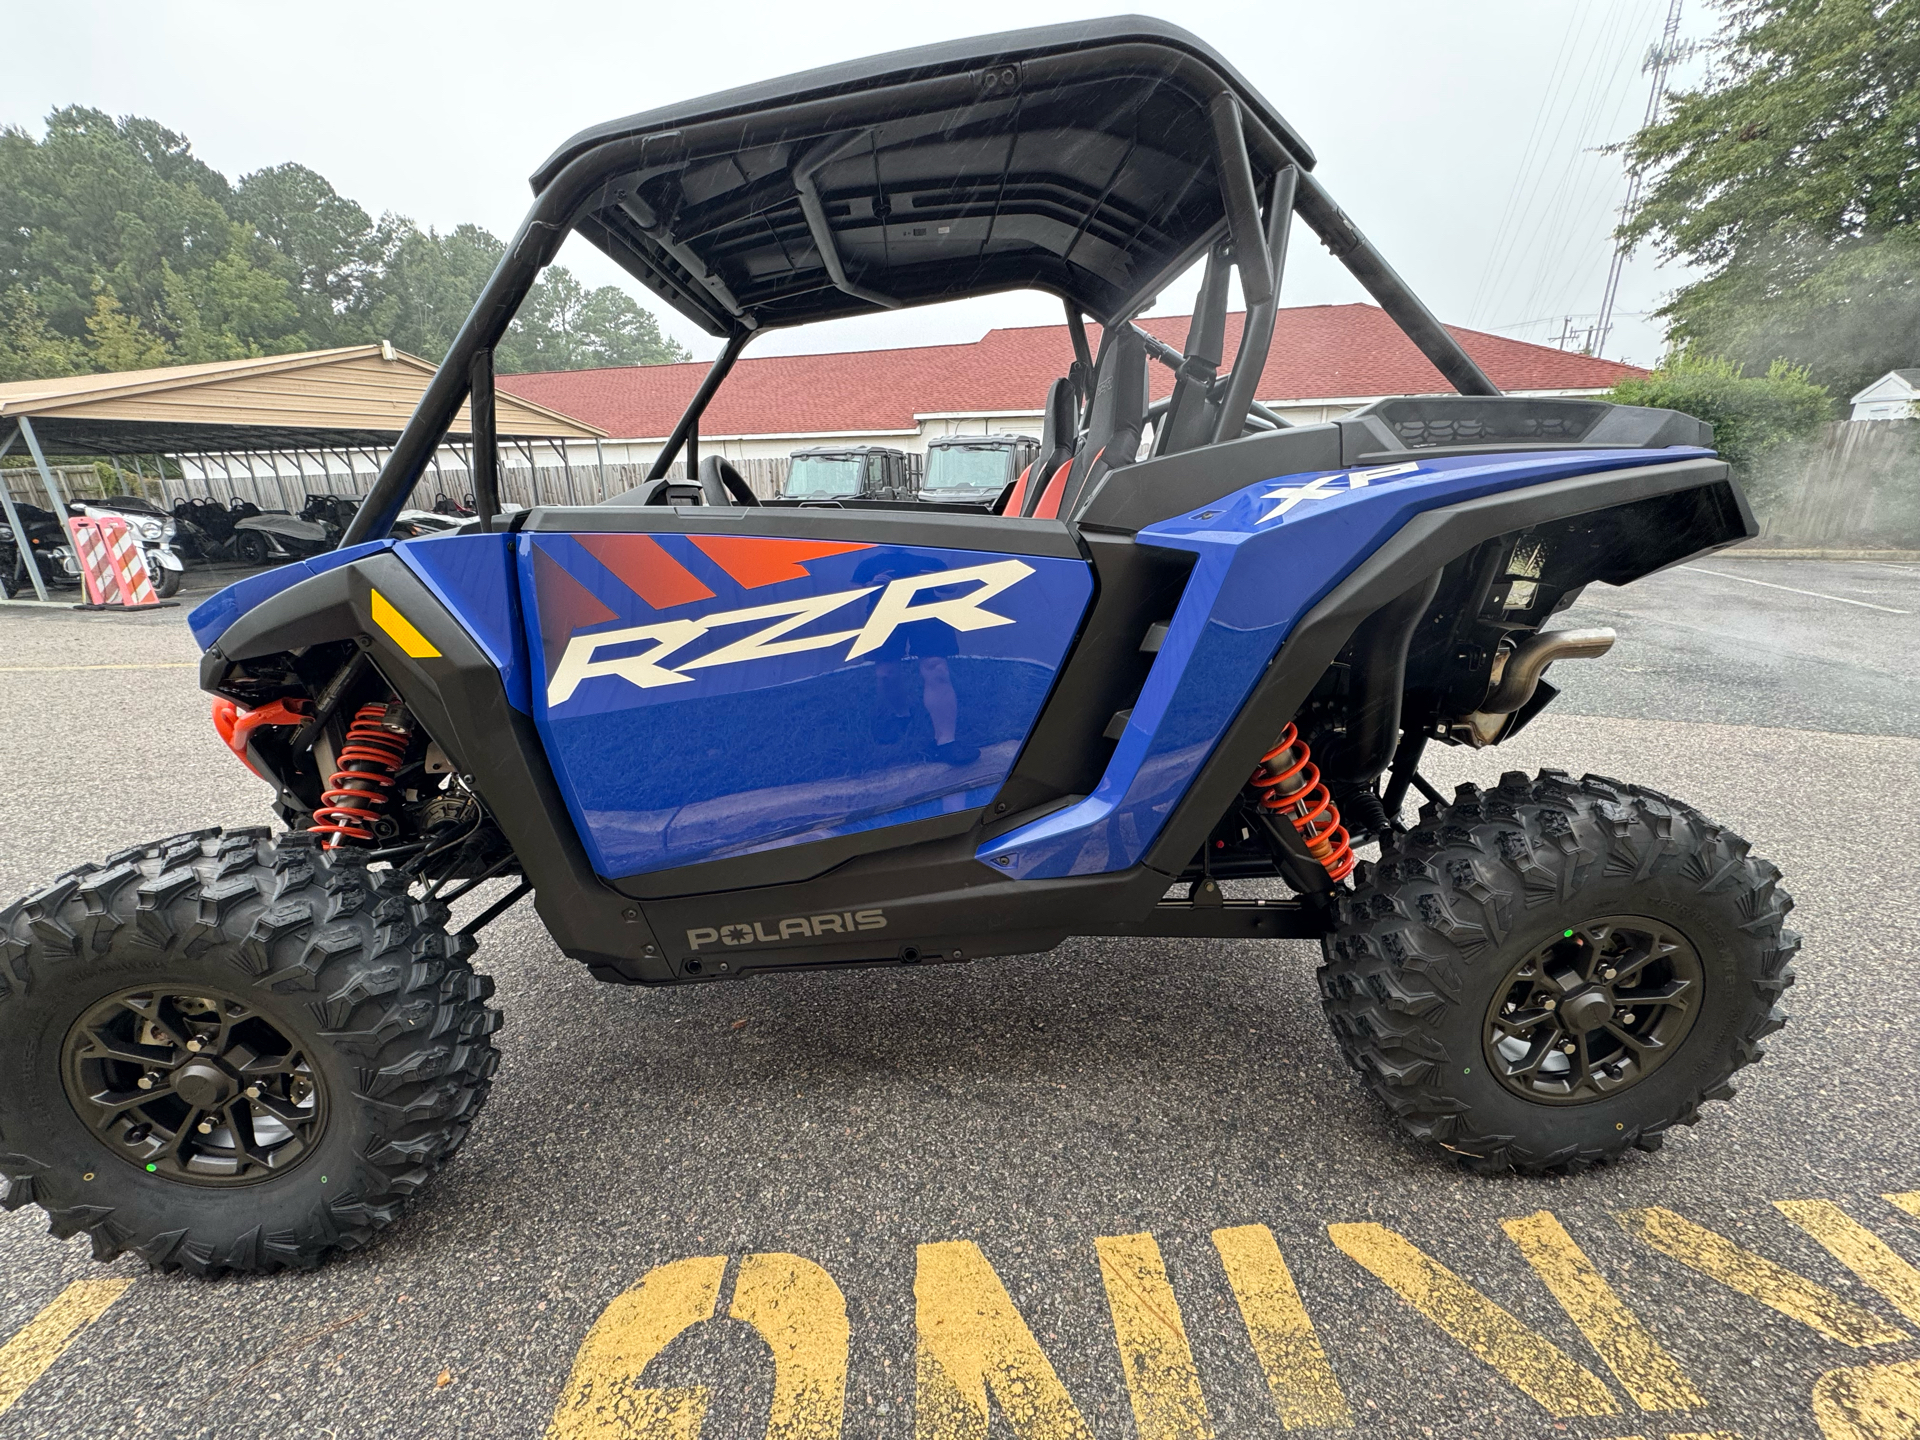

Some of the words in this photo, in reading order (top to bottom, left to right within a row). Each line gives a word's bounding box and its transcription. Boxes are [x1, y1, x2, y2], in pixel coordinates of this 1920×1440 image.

[1254, 462, 1420, 527] XP
[547, 559, 1036, 708] RZR
[686, 908, 889, 951] POLARIS
